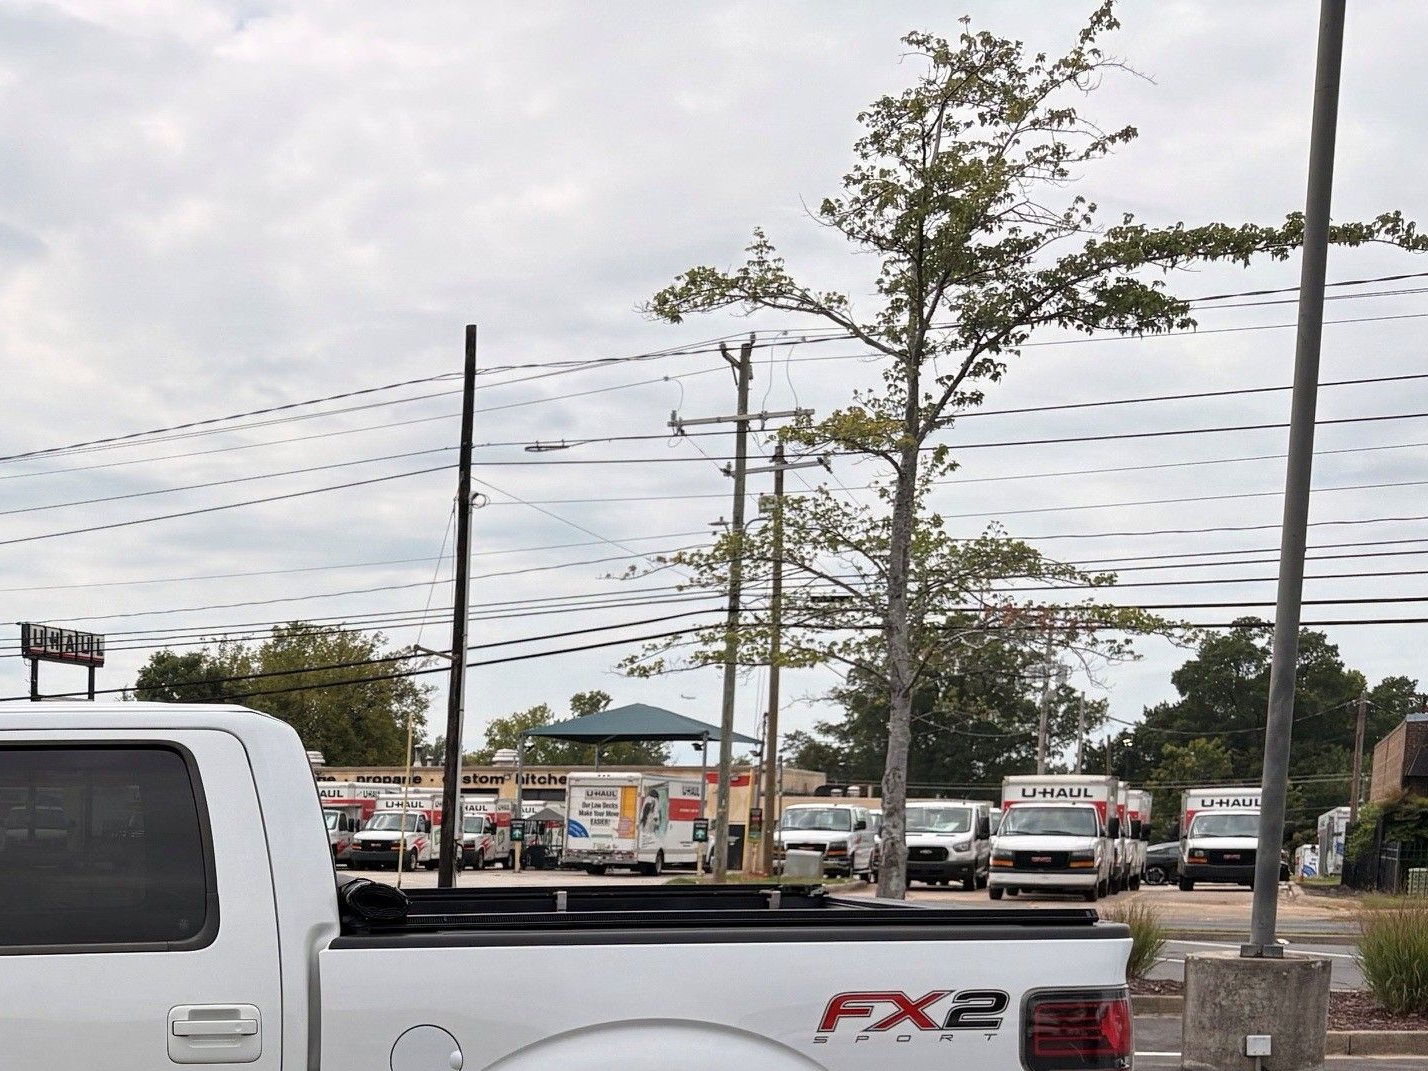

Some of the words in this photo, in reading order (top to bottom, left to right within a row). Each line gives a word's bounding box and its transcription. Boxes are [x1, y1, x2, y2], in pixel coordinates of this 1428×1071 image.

[356, 775, 422, 784] propane
[461, 773, 505, 784] stom
[515, 773, 567, 785] hitche
[320, 789, 344, 798] AUL
[1021, 787, 1093, 798] U-HAUL
[385, 800, 425, 808] U-HAUL
[1201, 798, 1262, 808] U-HAUL
[817, 988, 1010, 1032] FX2
